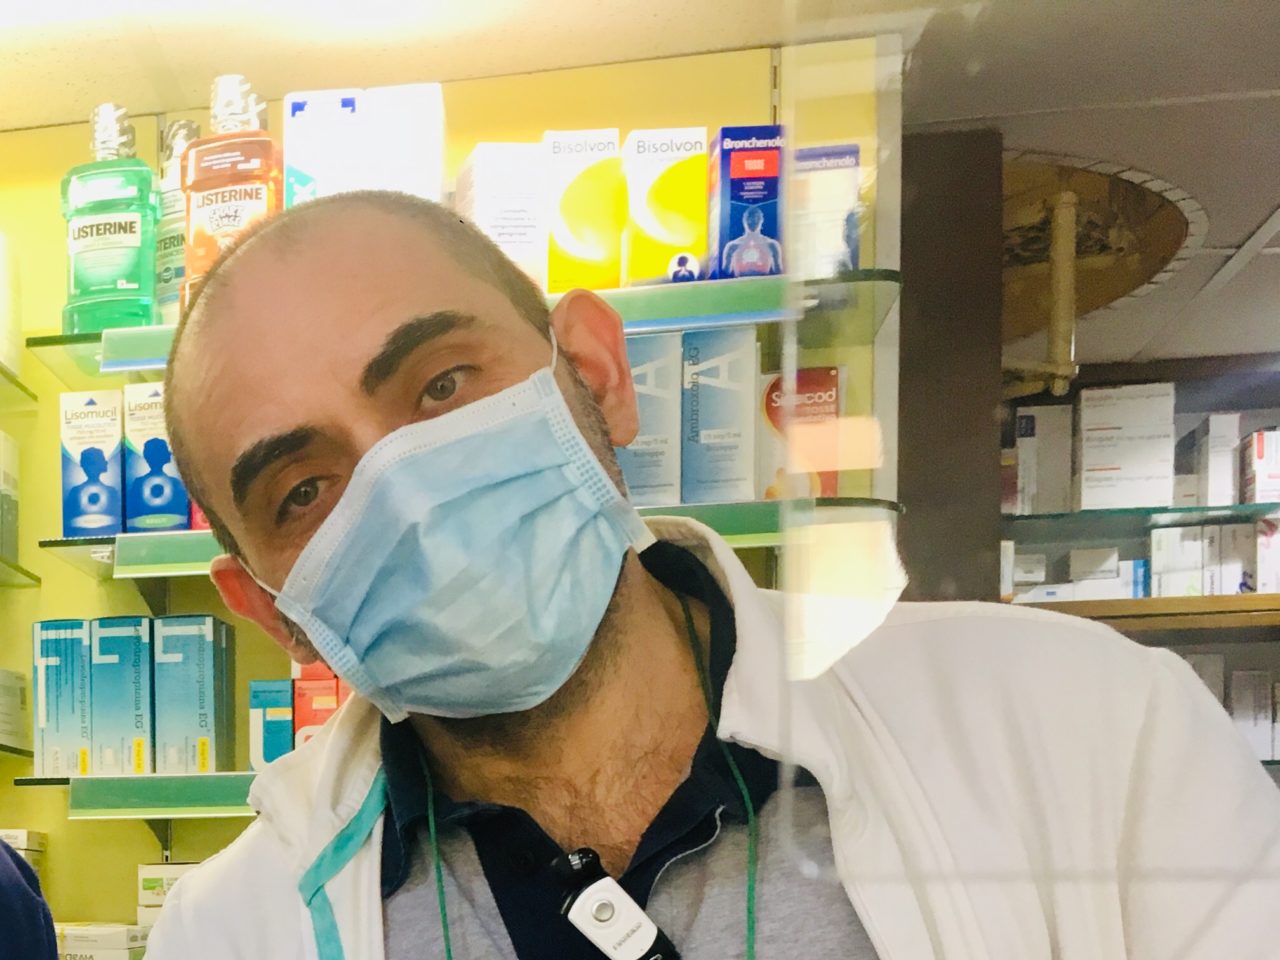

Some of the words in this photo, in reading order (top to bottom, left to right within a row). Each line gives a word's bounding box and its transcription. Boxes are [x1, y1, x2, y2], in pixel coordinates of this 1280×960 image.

[552, 139, 616, 155] Bisolvon
[636, 137, 703, 154] Bisolvon
[196, 186, 263, 208] LISTERINE
[72, 220, 137, 241] LISTERINE
[64, 406, 117, 421] Lisomucil
[687, 372, 700, 444] Ambroxolo
